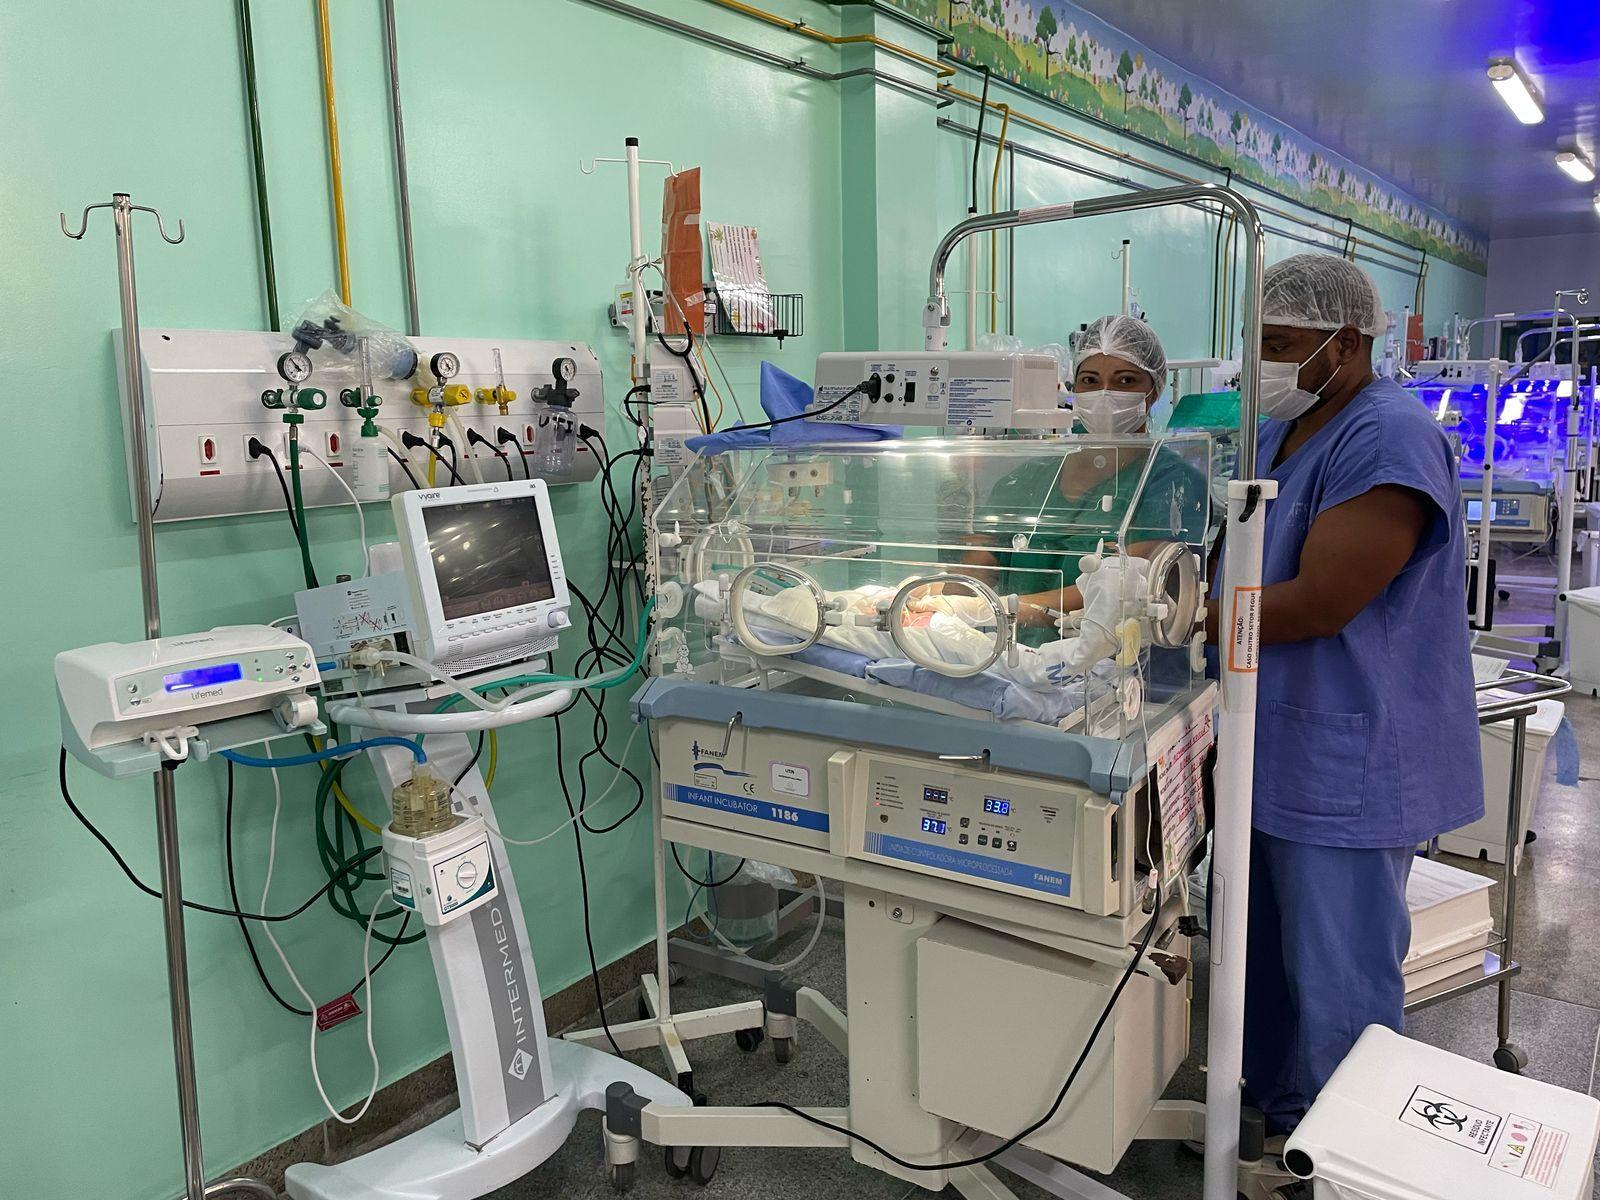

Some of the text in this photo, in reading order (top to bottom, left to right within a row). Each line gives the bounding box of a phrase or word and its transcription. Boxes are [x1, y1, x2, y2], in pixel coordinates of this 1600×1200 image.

[1236, 616, 1245, 646] ATENÇÃO:
[687, 792, 758, 814] INFANT INCUBATOR
[985, 800, 1009, 814] 33.8
[771, 807, 799, 822] 1186
[1034, 873, 1063, 885] FANEM
[490, 907, 526, 1043] INTERMED
